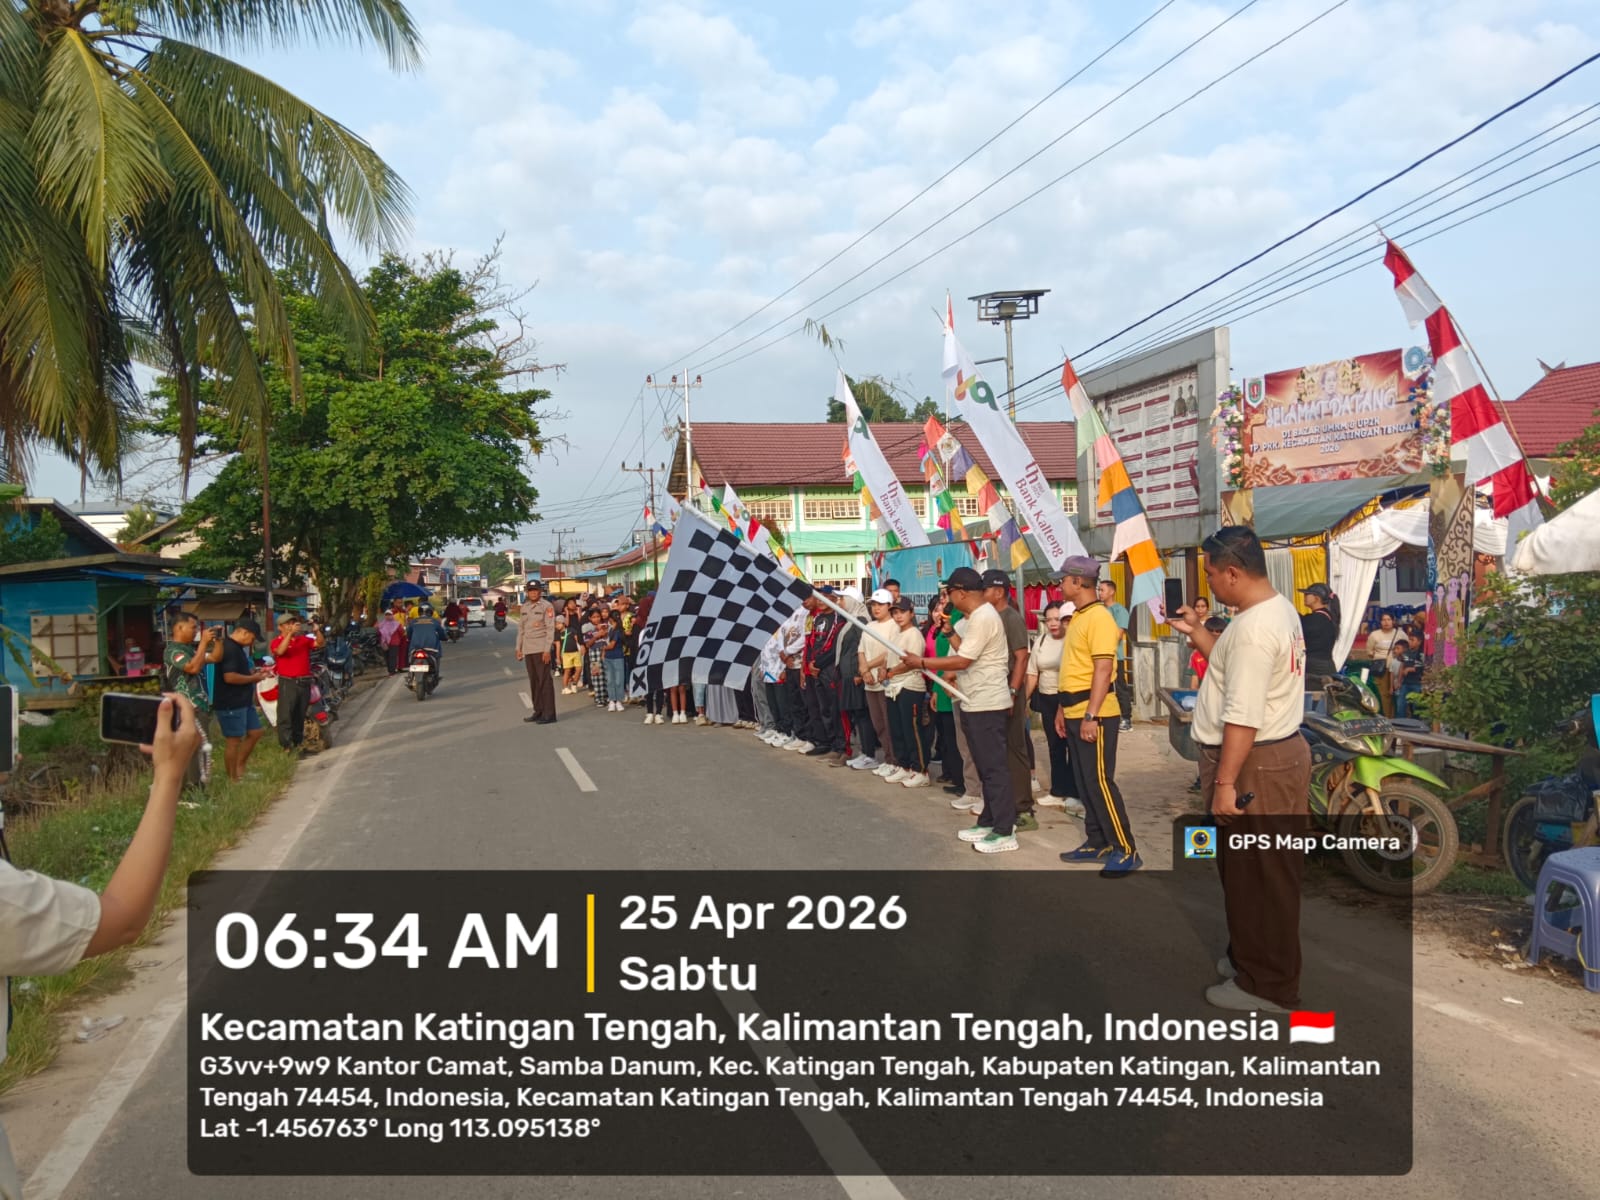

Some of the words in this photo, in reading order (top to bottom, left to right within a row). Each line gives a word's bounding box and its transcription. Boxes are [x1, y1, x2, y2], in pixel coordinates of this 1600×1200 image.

[1266, 401, 1329, 428] SELAMAT
[1329, 388, 1396, 417] DATANG
[1282, 434, 1332, 449] KECAMATAN
[1333, 427, 1380, 442] KATINGAN
[880, 493, 897, 518] Bank
[1016, 478, 1038, 511] Bank
[1034, 510, 1064, 558] Kalteng
